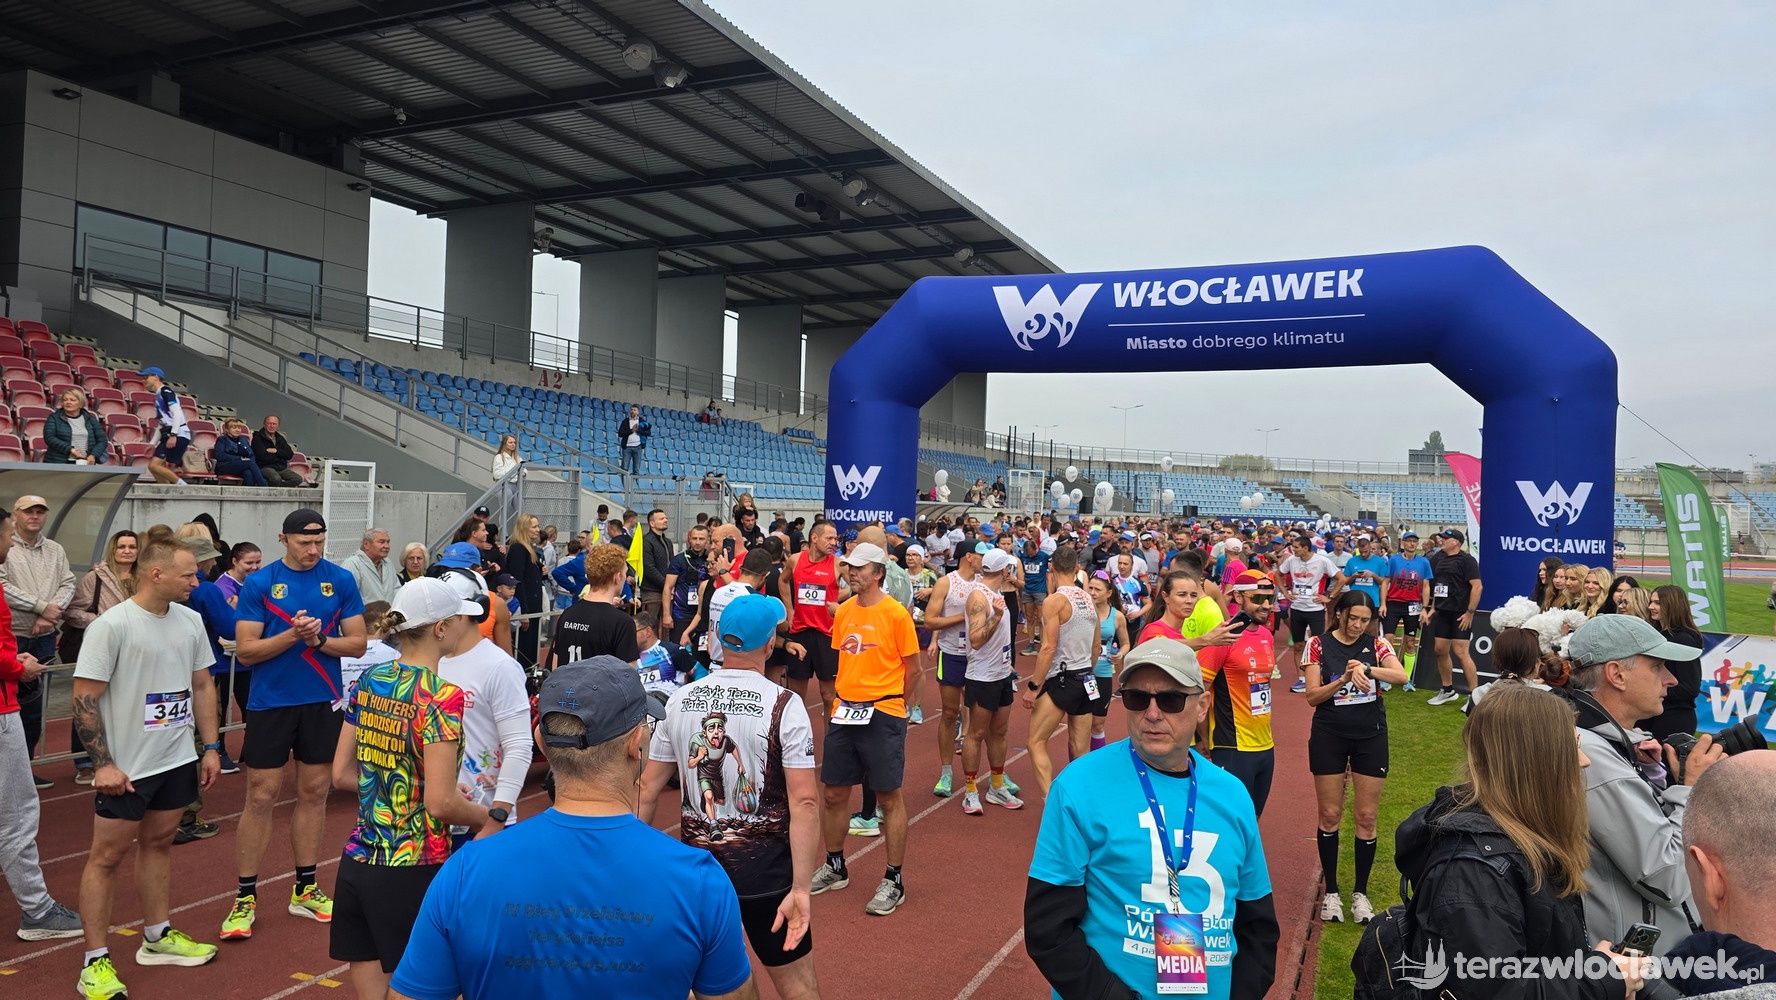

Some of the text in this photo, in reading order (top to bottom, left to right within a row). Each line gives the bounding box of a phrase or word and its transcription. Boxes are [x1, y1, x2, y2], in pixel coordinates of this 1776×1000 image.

[1113, 268, 1364, 308] WŁOCŁAWEK
[1127, 331, 1345, 350] Miasto dobrego klimatu
[825, 509, 894, 523] WŁOCŁAWEK
[1500, 535, 1606, 555] WŁOCŁAWEK
[804, 590, 818, 599] 60
[727, 687, 762, 702] Team
[154, 700, 188, 720] 344
[370, 694, 417, 719] HUNTERS
[681, 697, 708, 712] Tata
[843, 708, 869, 719] 100
[1157, 955, 1205, 974] MEDIA
